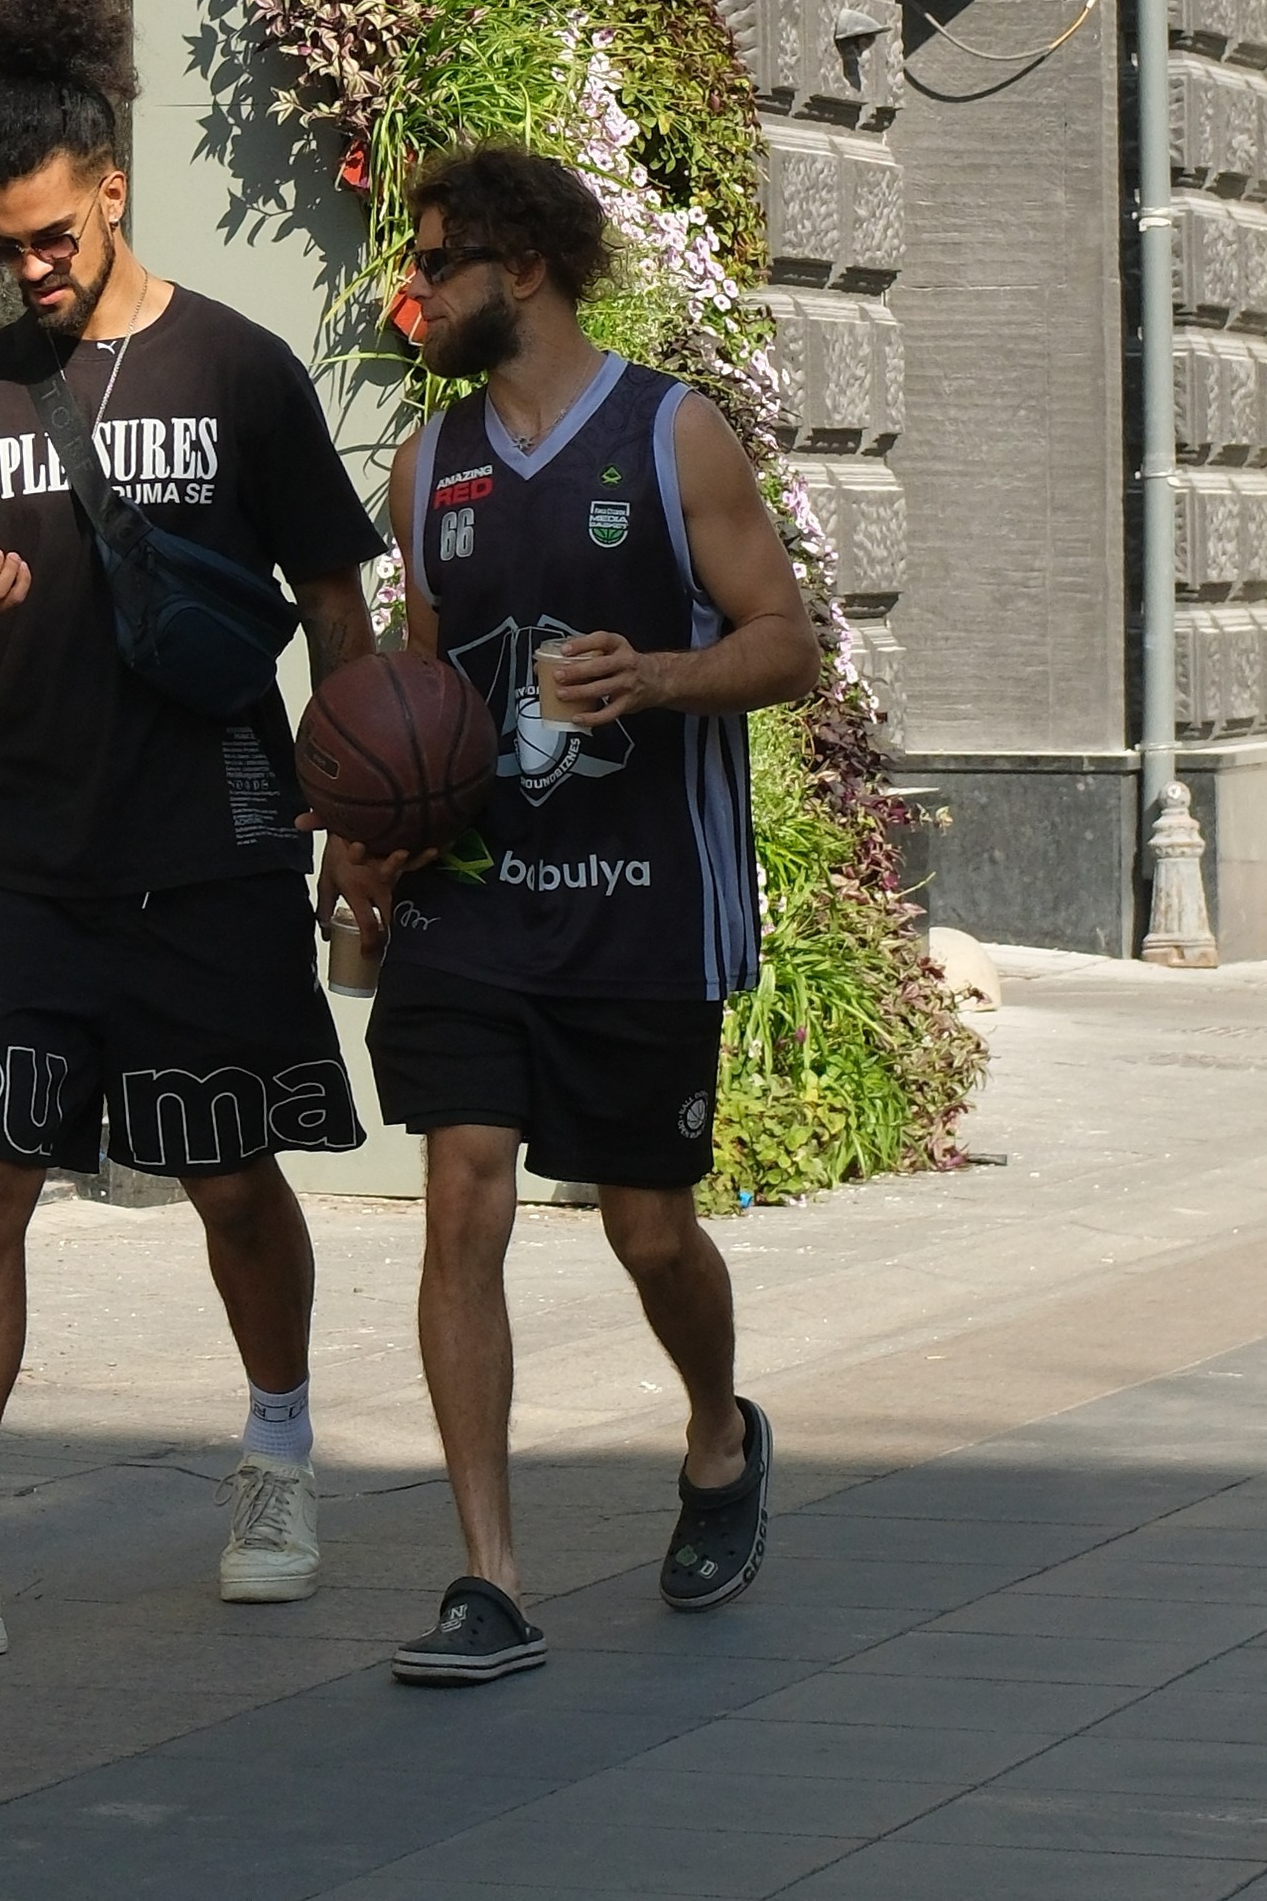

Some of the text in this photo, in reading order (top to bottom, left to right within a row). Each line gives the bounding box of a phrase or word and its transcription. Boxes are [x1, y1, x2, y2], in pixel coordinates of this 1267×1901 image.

[436, 464, 493, 490] AMAZING
[184, 483, 214, 505] SE
[432, 477, 494, 510] RED
[440, 507, 475, 562] 66
